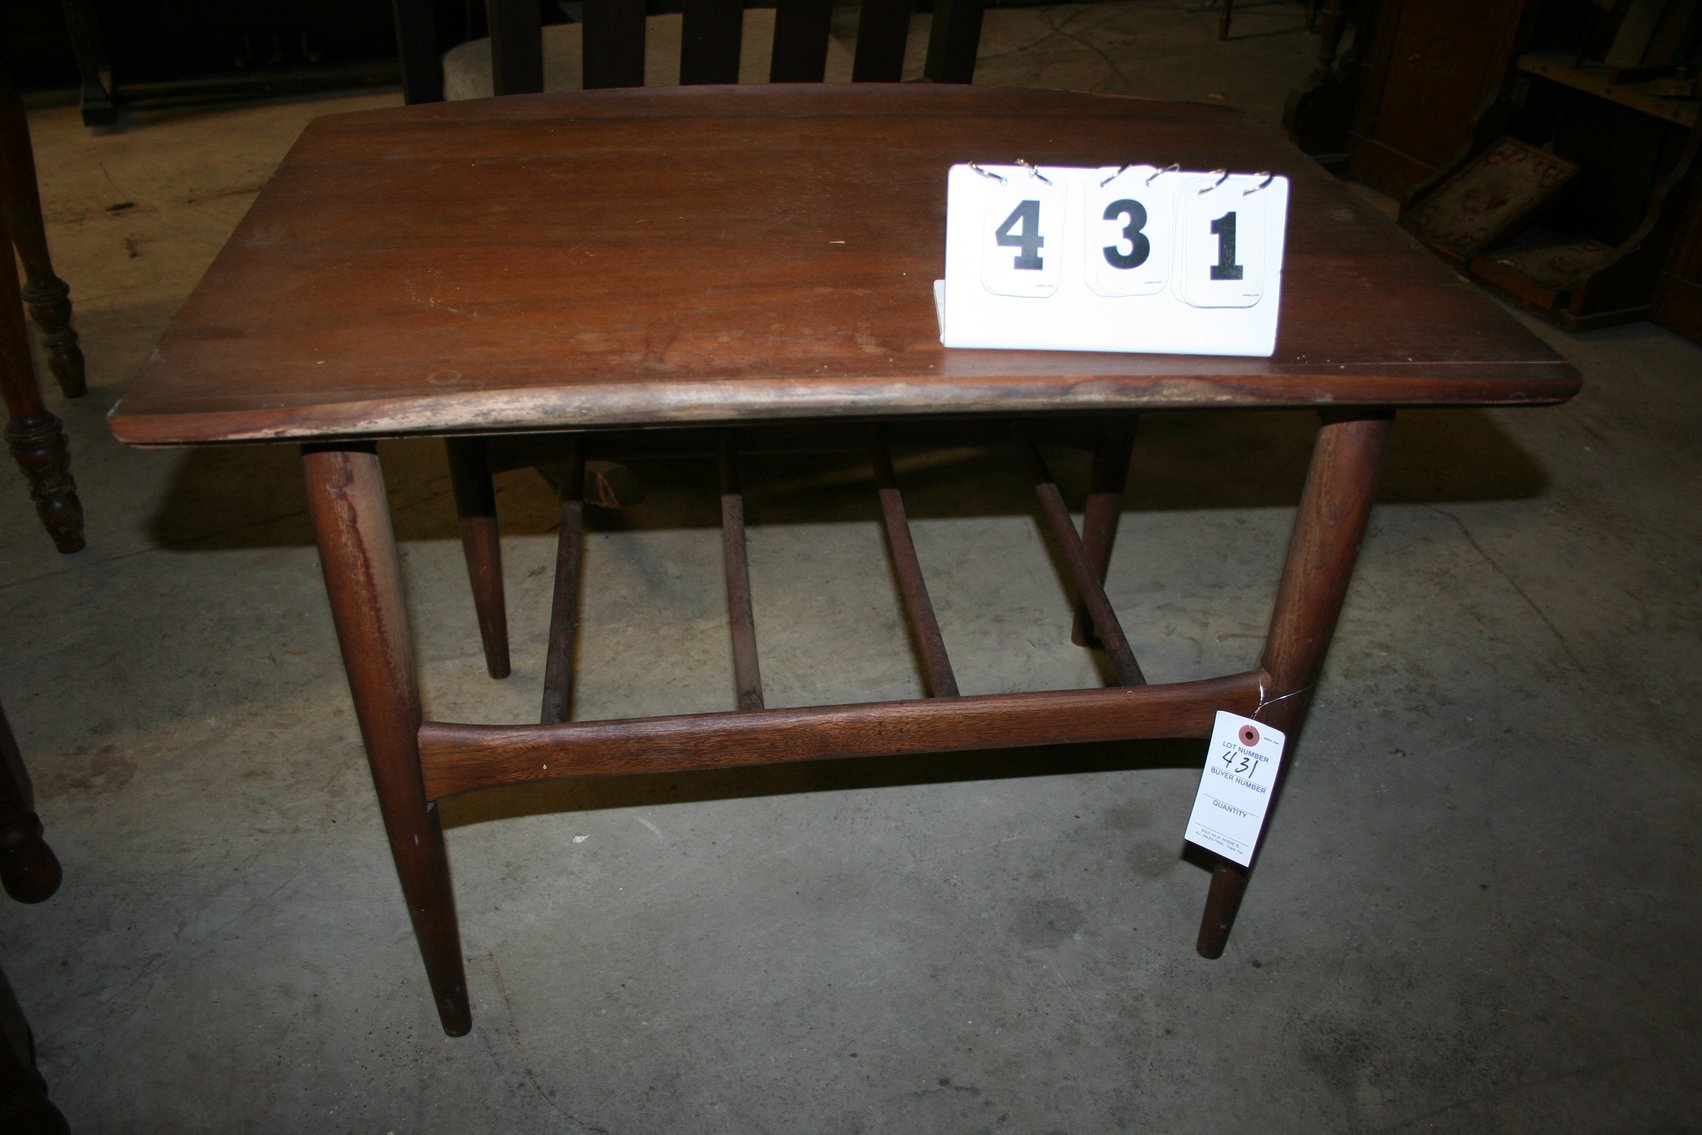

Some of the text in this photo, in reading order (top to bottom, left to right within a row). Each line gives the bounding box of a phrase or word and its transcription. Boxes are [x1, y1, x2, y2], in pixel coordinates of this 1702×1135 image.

[995, 199, 1244, 280] 4 3 1
[1222, 741, 1269, 763] LOT NUMBER
[1222, 751, 1258, 779] 431
[1210, 766, 1266, 794] BUYER NUMBER
[1212, 799, 1247, 819] QUANTITY
